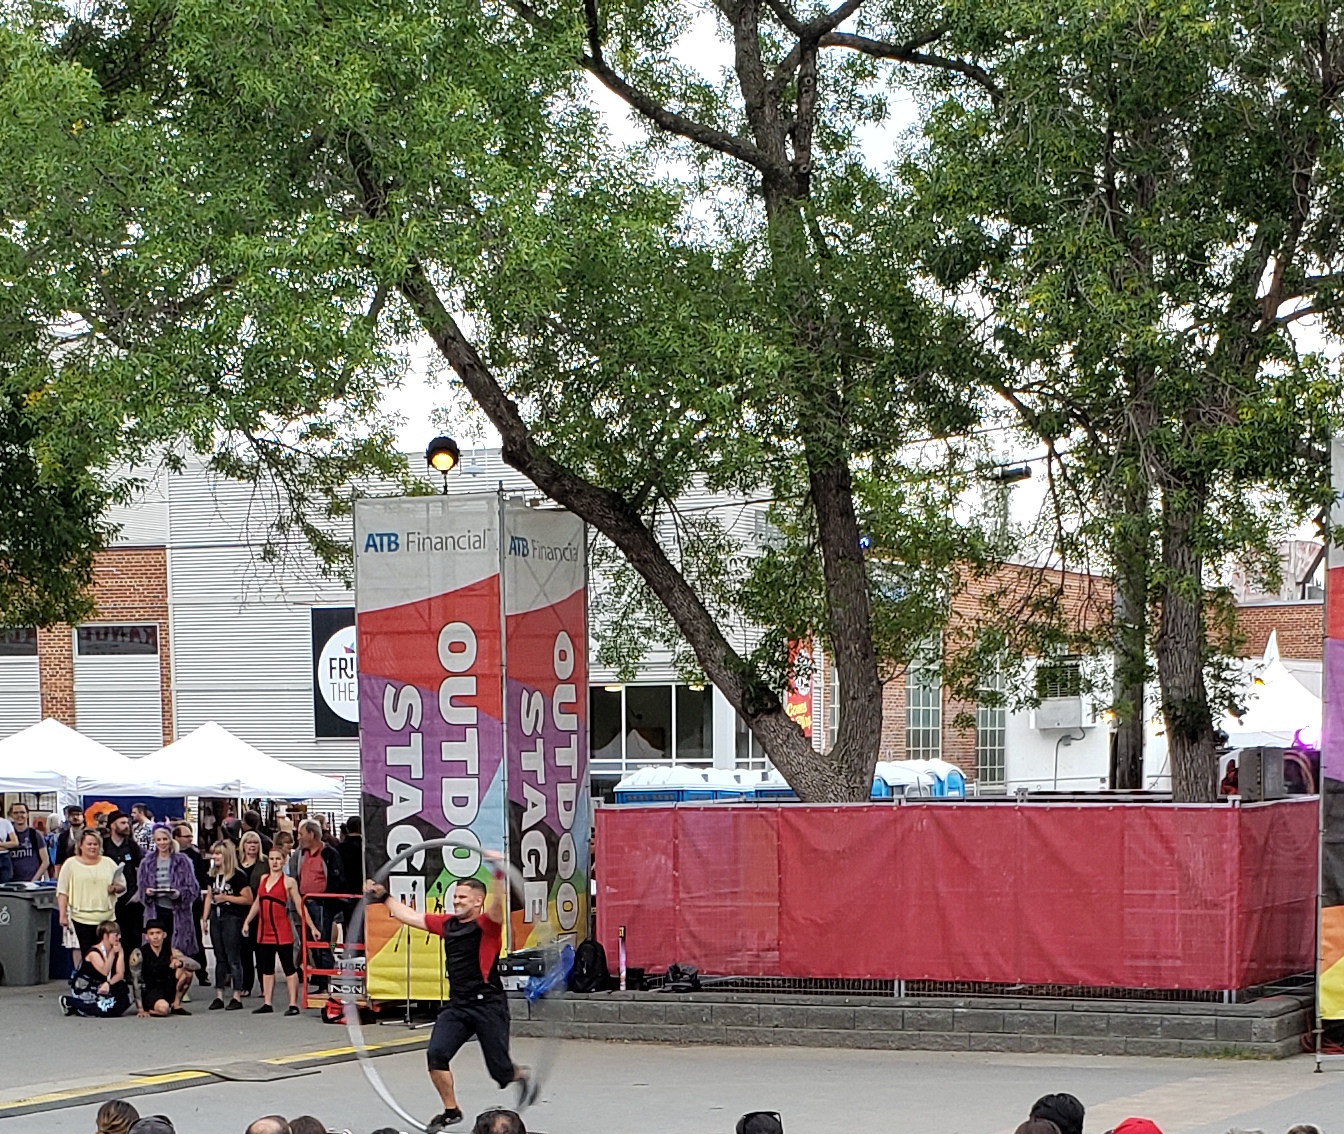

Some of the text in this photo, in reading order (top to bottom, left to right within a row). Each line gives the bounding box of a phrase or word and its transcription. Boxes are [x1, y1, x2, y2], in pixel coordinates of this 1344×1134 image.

[364, 529, 487, 553] ATB Financial
[508, 535, 579, 562] ATB Financia
[383, 684, 426, 917] STAGE
[520, 689, 550, 925] STAGE
